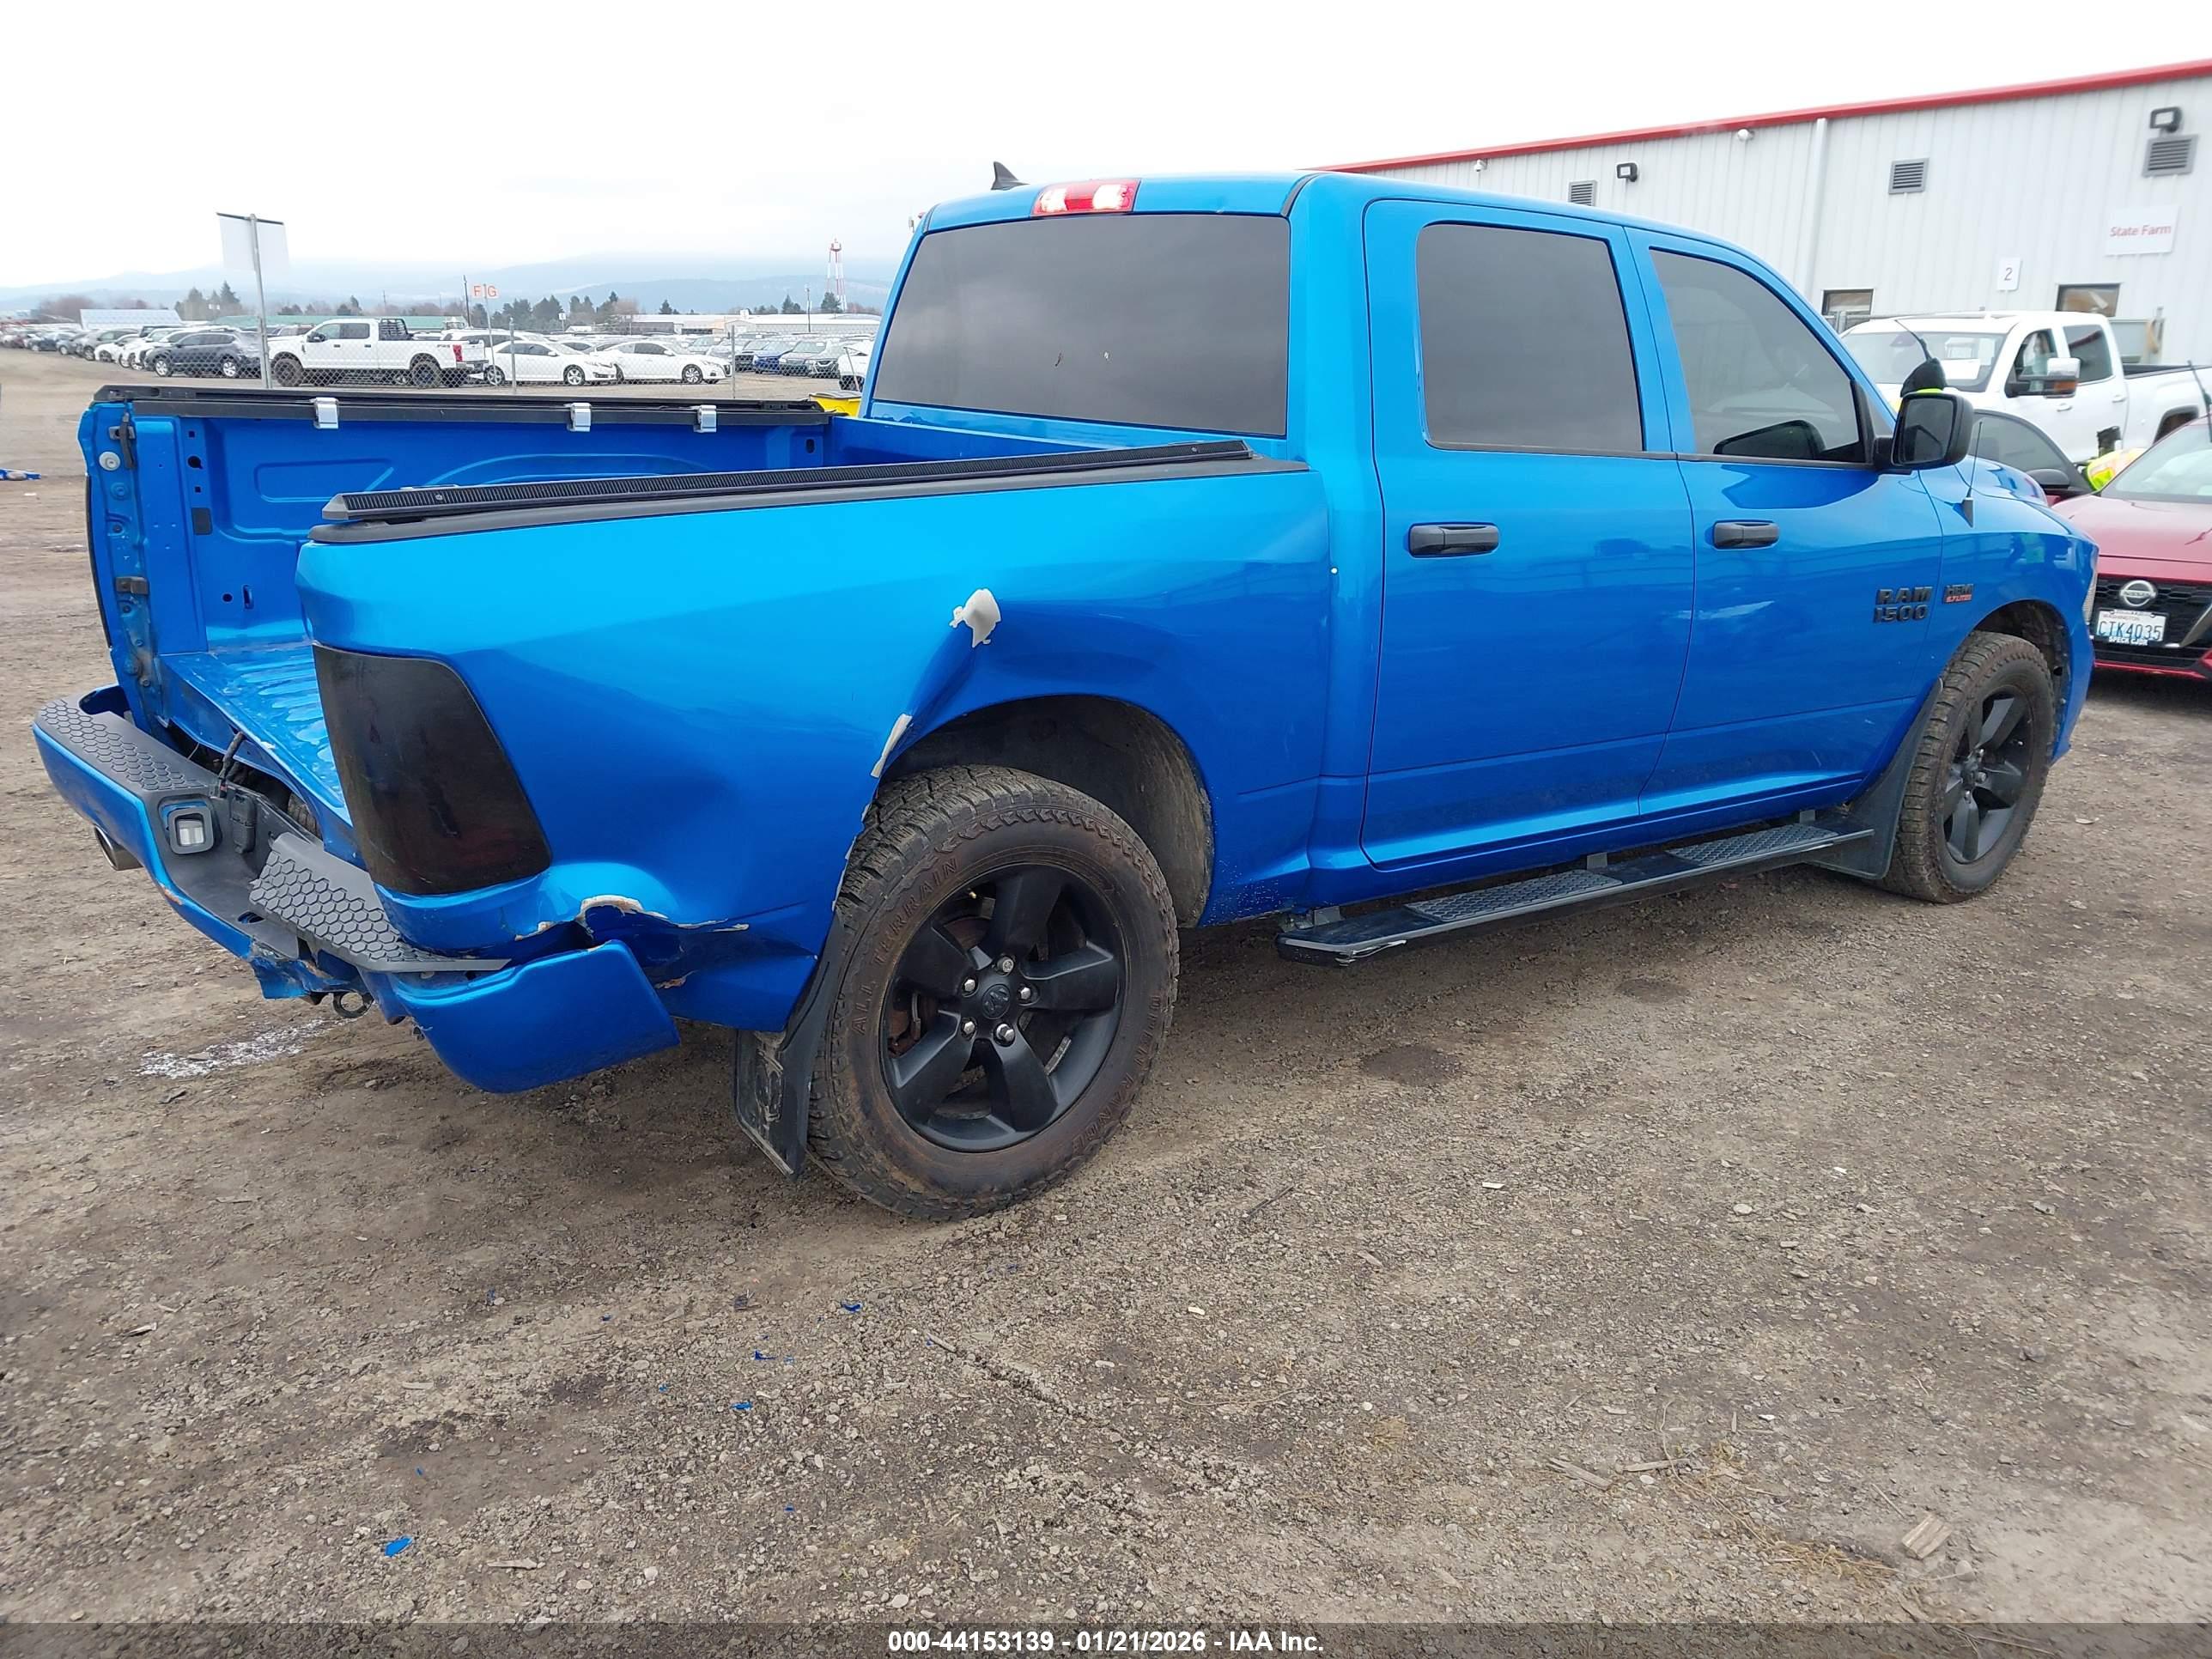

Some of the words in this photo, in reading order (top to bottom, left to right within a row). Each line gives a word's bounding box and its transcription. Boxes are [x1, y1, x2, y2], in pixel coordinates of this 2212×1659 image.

[2110, 226, 2138, 237] State
[2142, 224, 2172, 235] Farm
[2004, 267, 2013, 281] 2
[473, 285, 481, 296] F
[487, 285, 496, 297] G
[1875, 586, 1933, 604] RAM
[1944, 584, 1974, 595] HEM
[1874, 605, 1929, 623] 1500
[2099, 621, 2163, 640] CTK4035
[851, 981, 877, 1036] ALL
